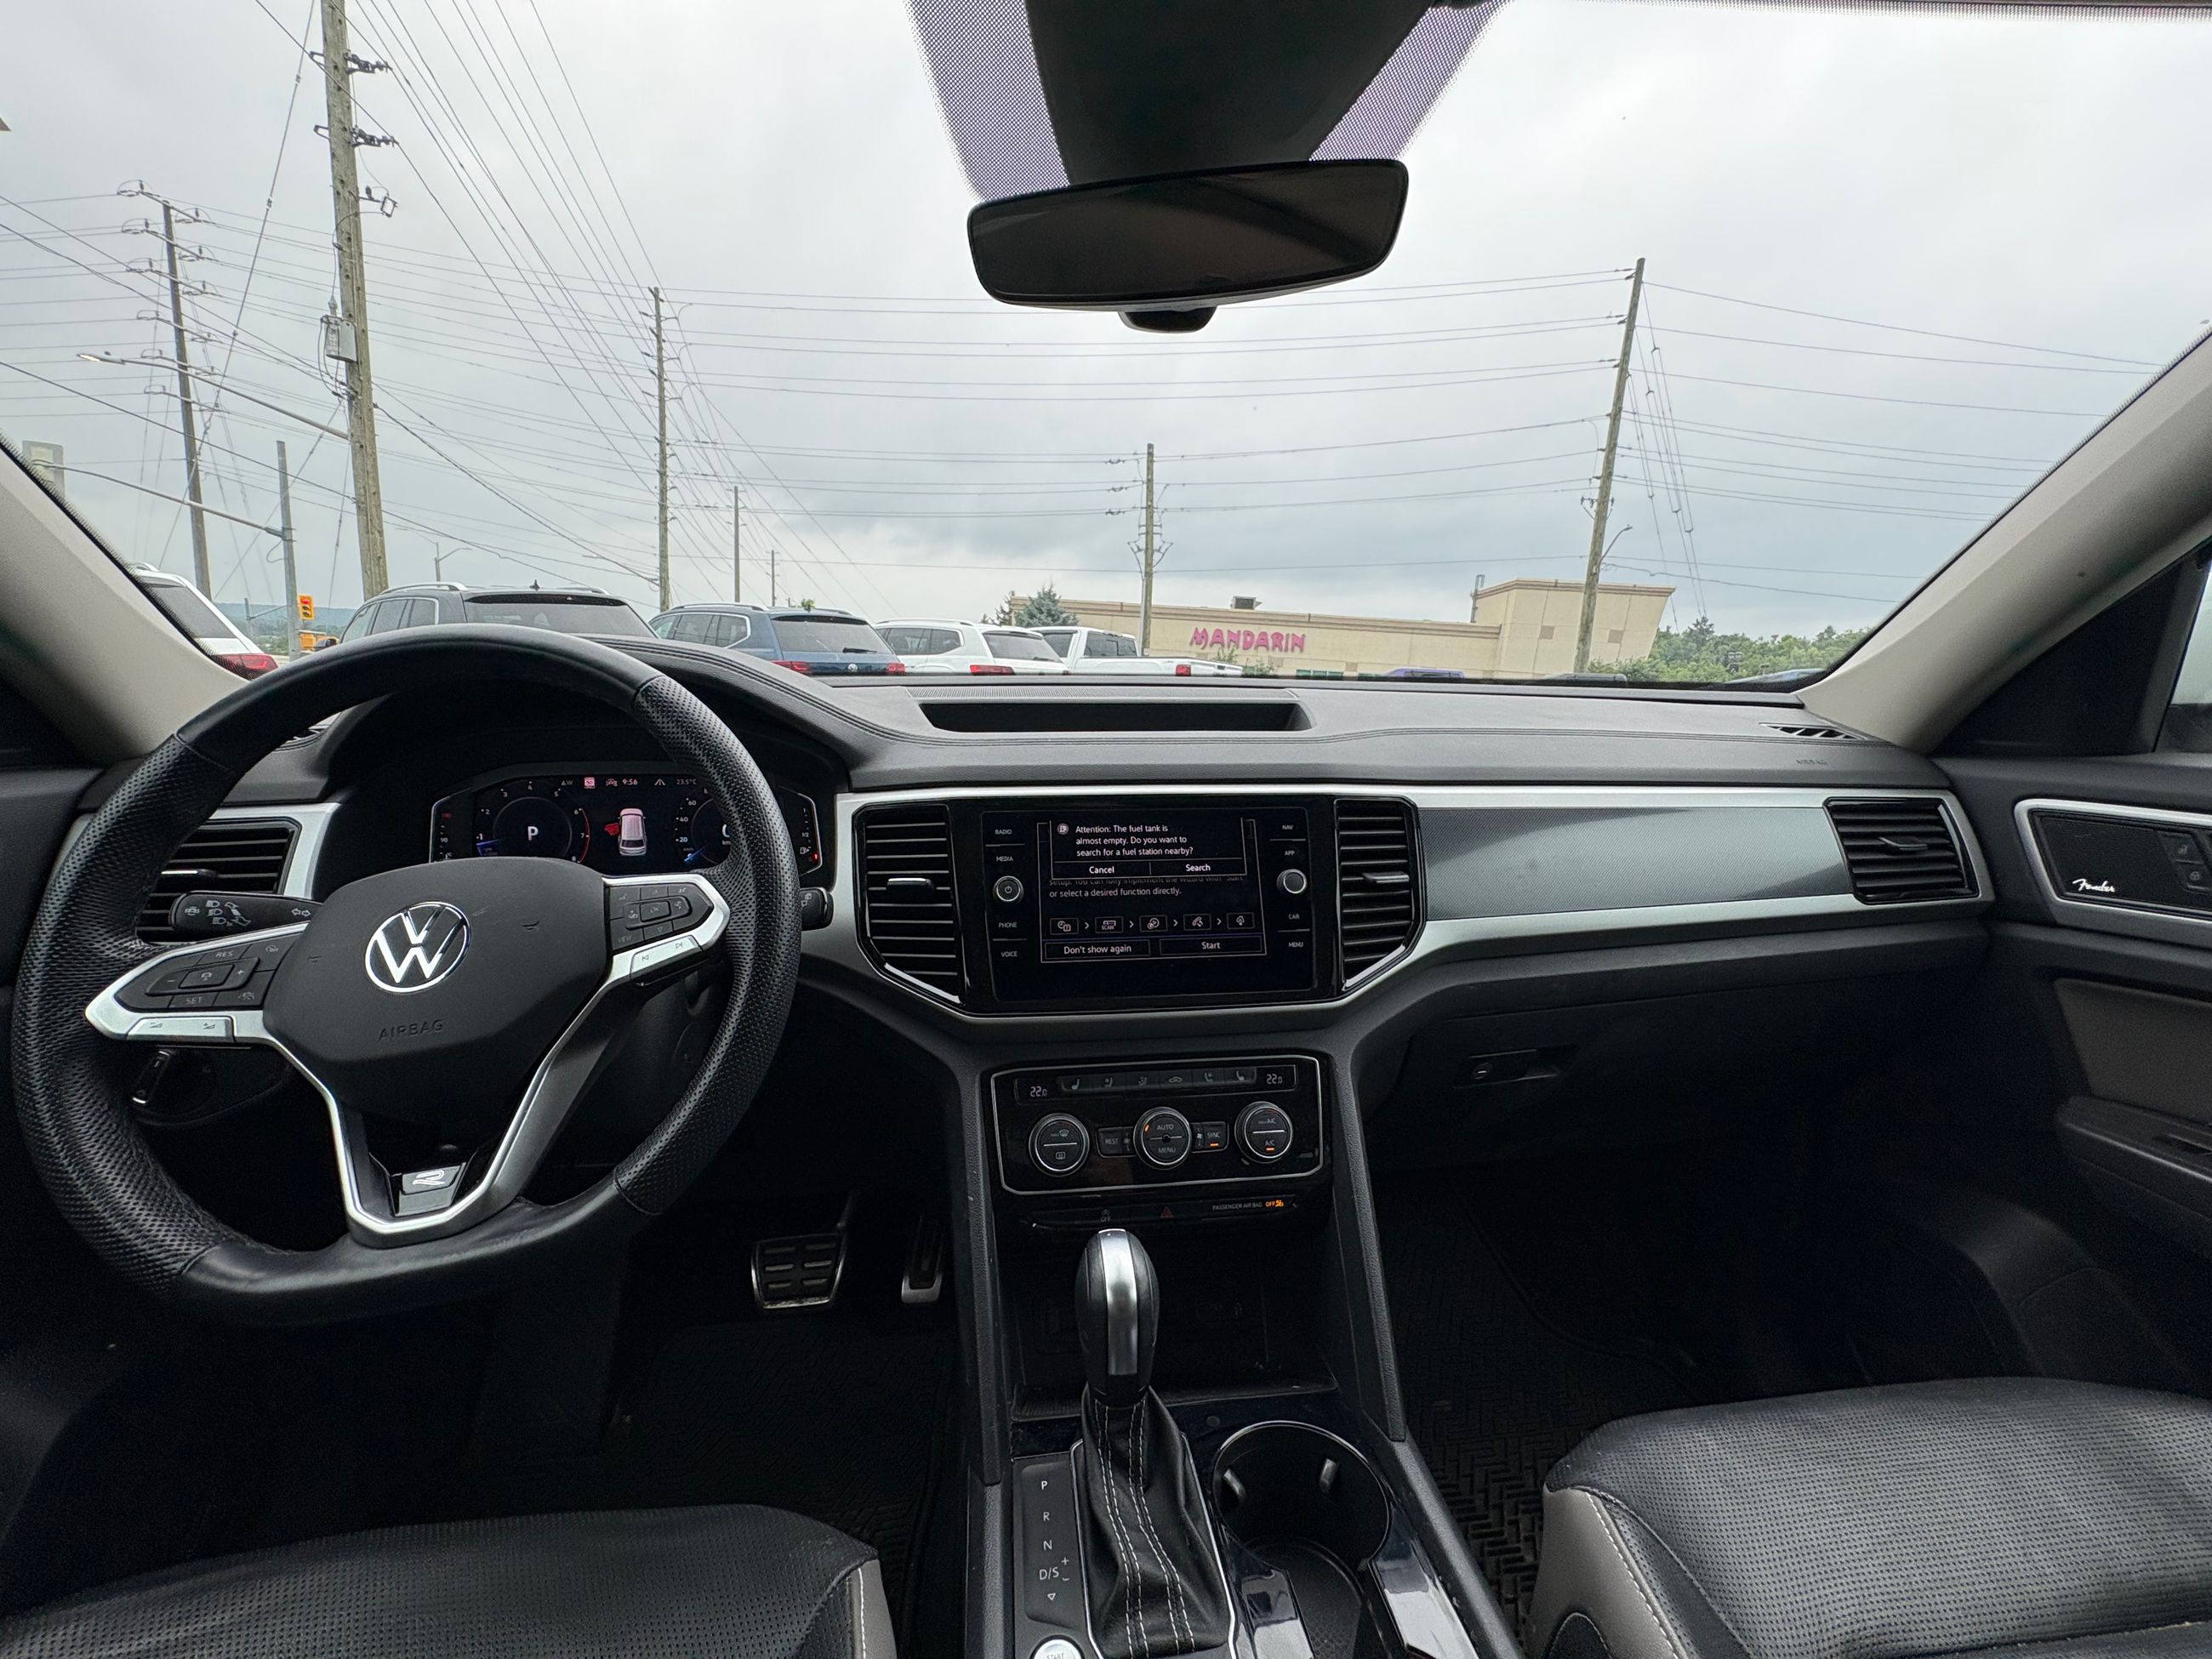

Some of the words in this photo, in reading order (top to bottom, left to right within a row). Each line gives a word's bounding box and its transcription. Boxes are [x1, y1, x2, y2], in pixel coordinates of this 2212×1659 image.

[1190, 627, 1306, 653] MANDARIN
[527, 826, 539, 841] P
[1165, 847, 1194, 856] nearby?
[1185, 864, 1211, 872] Search
[2072, 878, 2115, 892] Fender
[1152, 887, 1182, 896] directly.
[1063, 945, 1086, 955] Don't
[1110, 944, 1132, 954] again
[1201, 941, 1221, 949] Start
[185, 996, 202, 1005] SET
[378, 1019, 443, 1041] AIRBAG
[1041, 1480, 1048, 1490] P
[1043, 1511, 1050, 1521] R
[1044, 1540, 1052, 1550] N
[1040, 1566, 1059, 1581] D/S
